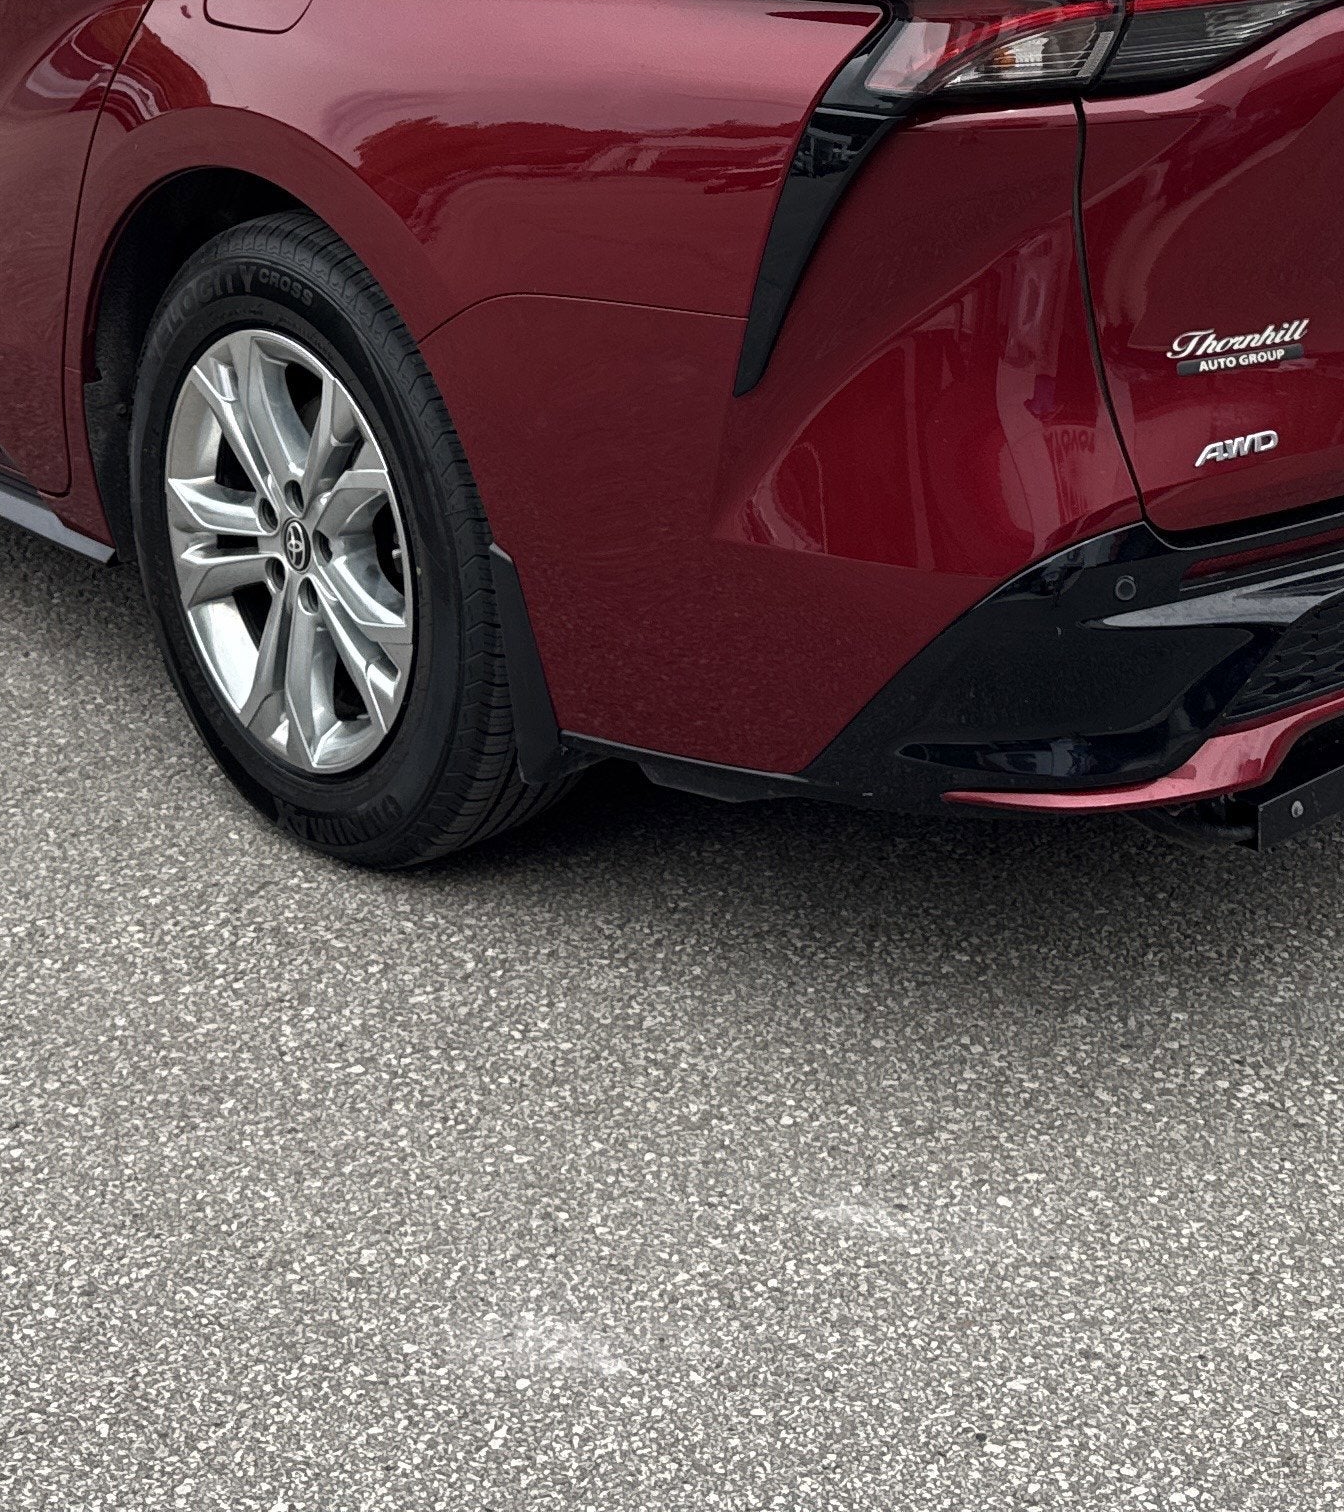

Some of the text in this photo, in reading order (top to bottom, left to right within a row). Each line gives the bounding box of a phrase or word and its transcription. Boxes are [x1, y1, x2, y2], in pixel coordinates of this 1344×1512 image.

[257, 267, 314, 307] CROSS
[1166, 317, 1311, 359] Thornhill
[1198, 348, 1285, 372] AUTO GROUP
[1194, 430, 1279, 468] AWD
